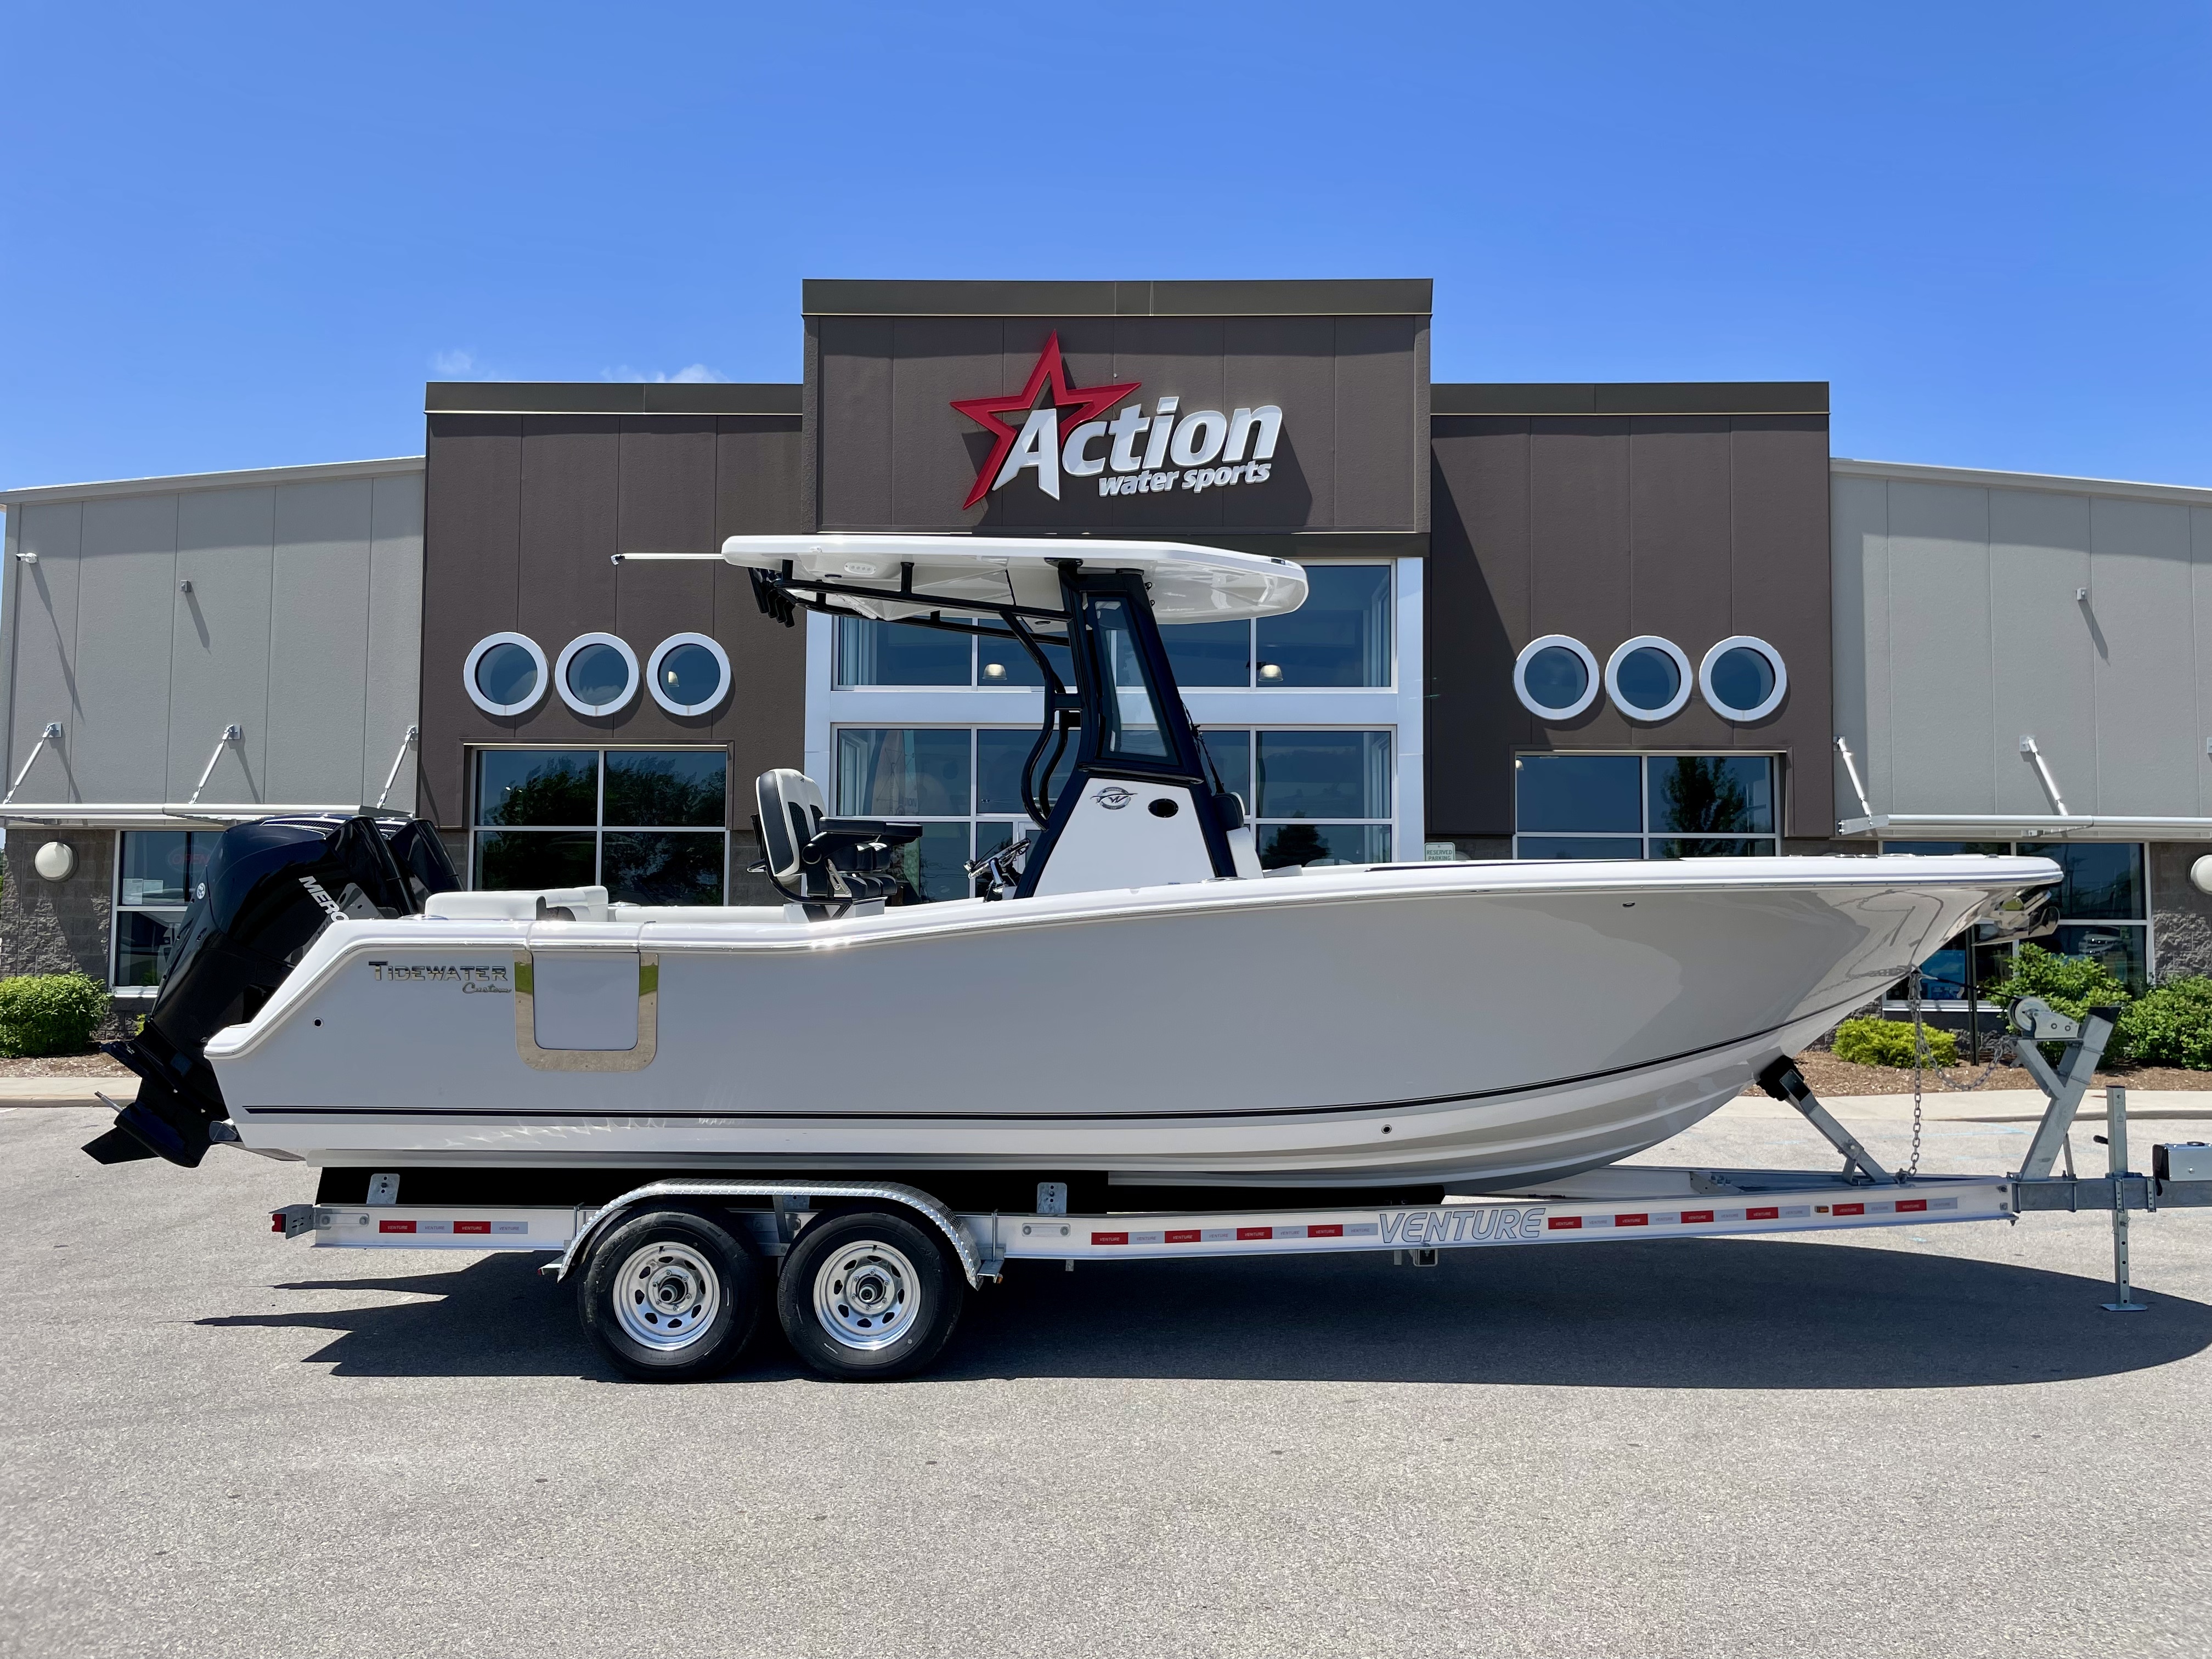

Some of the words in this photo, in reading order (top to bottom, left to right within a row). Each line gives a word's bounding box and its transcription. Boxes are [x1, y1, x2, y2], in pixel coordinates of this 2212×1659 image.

[992, 396, 1283, 501] Action
[1099, 470, 1178, 497] water
[1182, 460, 1272, 494] sports
[369, 961, 508, 981] TIDEWATER
[462, 981, 512, 994] Custom
[1380, 1208, 1547, 1243] VENTURE
